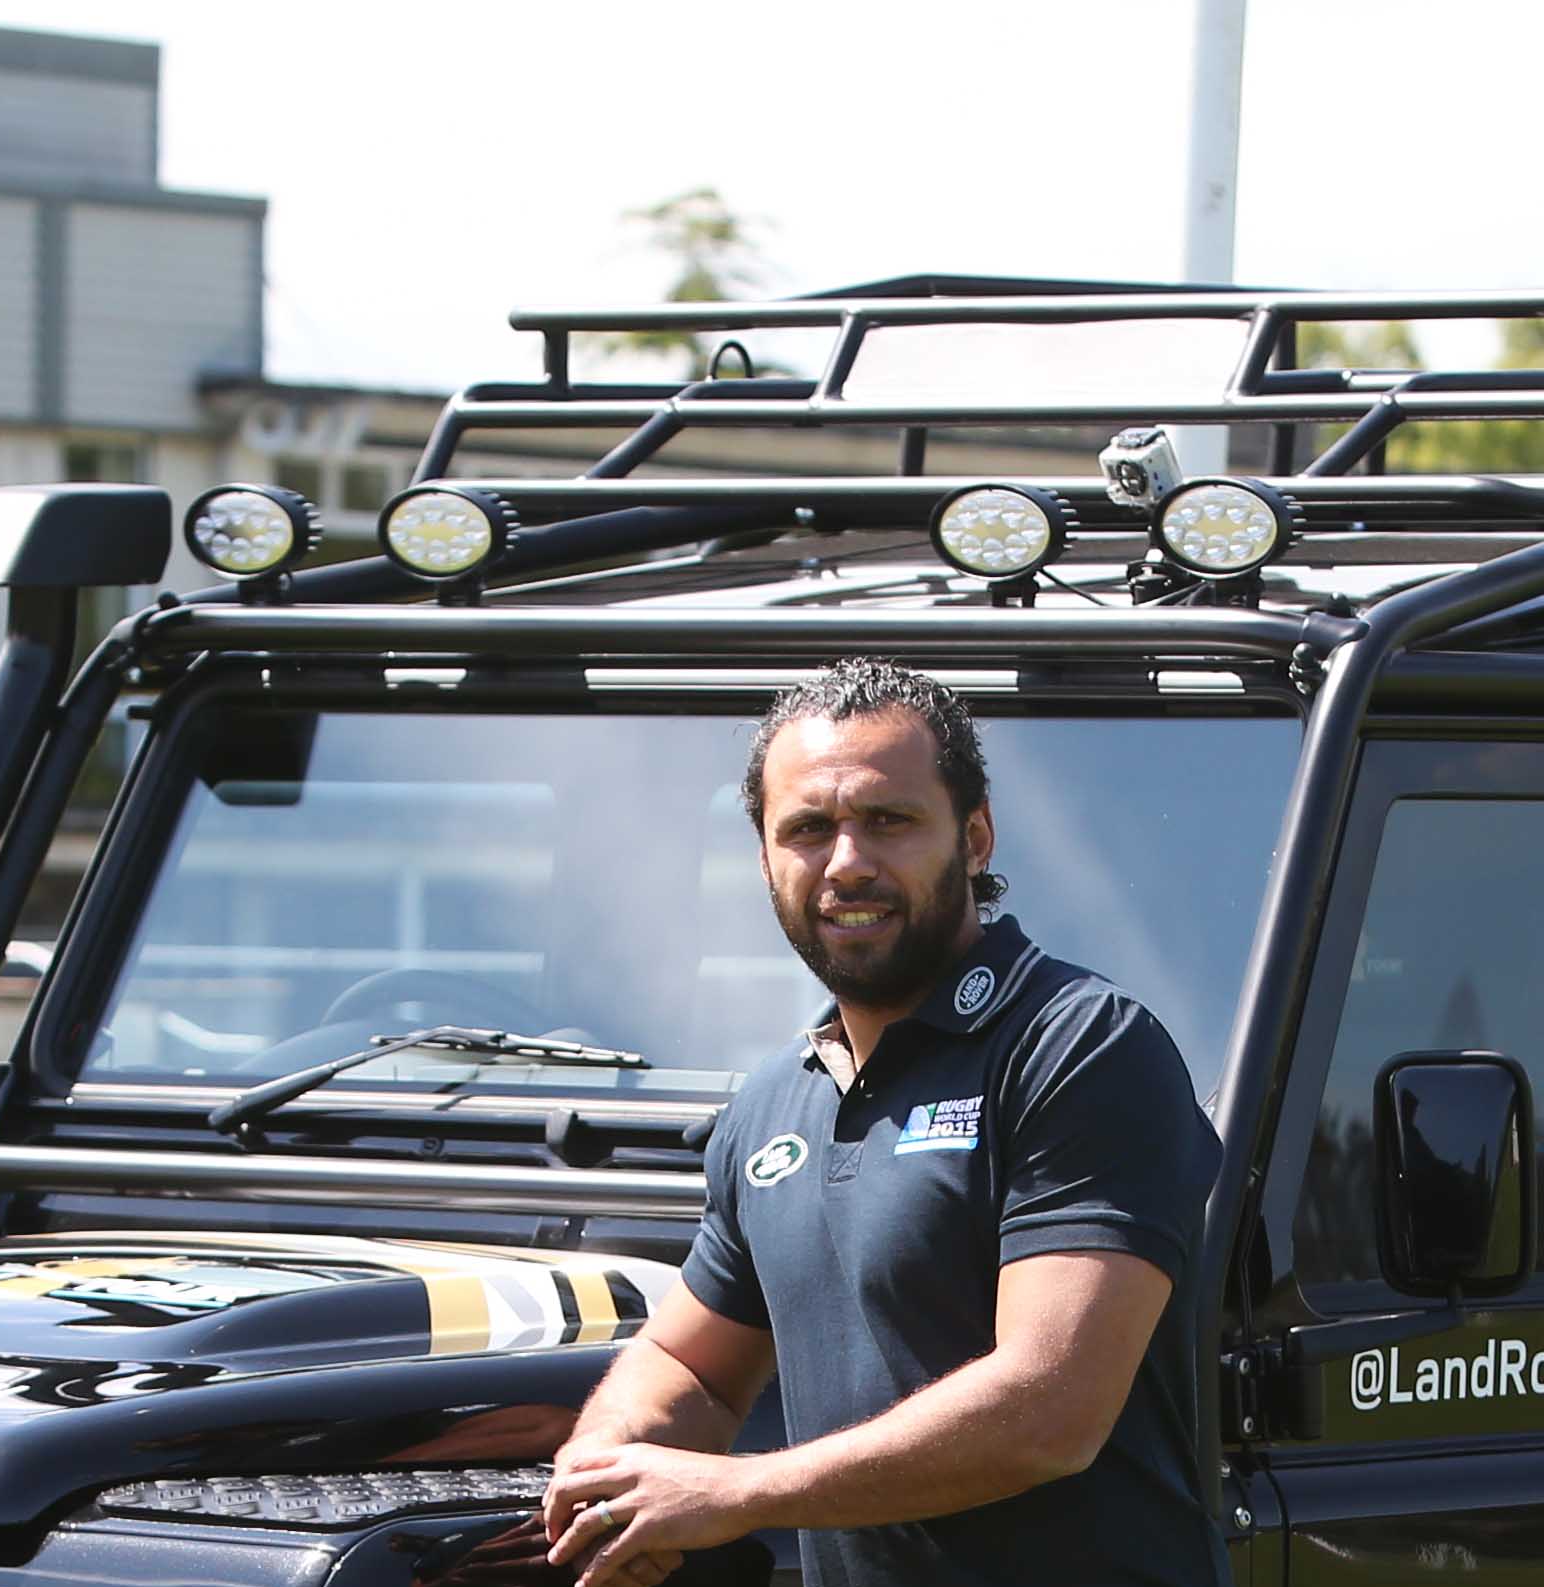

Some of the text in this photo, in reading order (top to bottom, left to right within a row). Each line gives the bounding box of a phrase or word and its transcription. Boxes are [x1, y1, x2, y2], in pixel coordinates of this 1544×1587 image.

[936, 1095, 984, 1114] RUGBY
[934, 1111, 981, 1123] WORLD CUP
[928, 1120, 979, 1138] 2015
